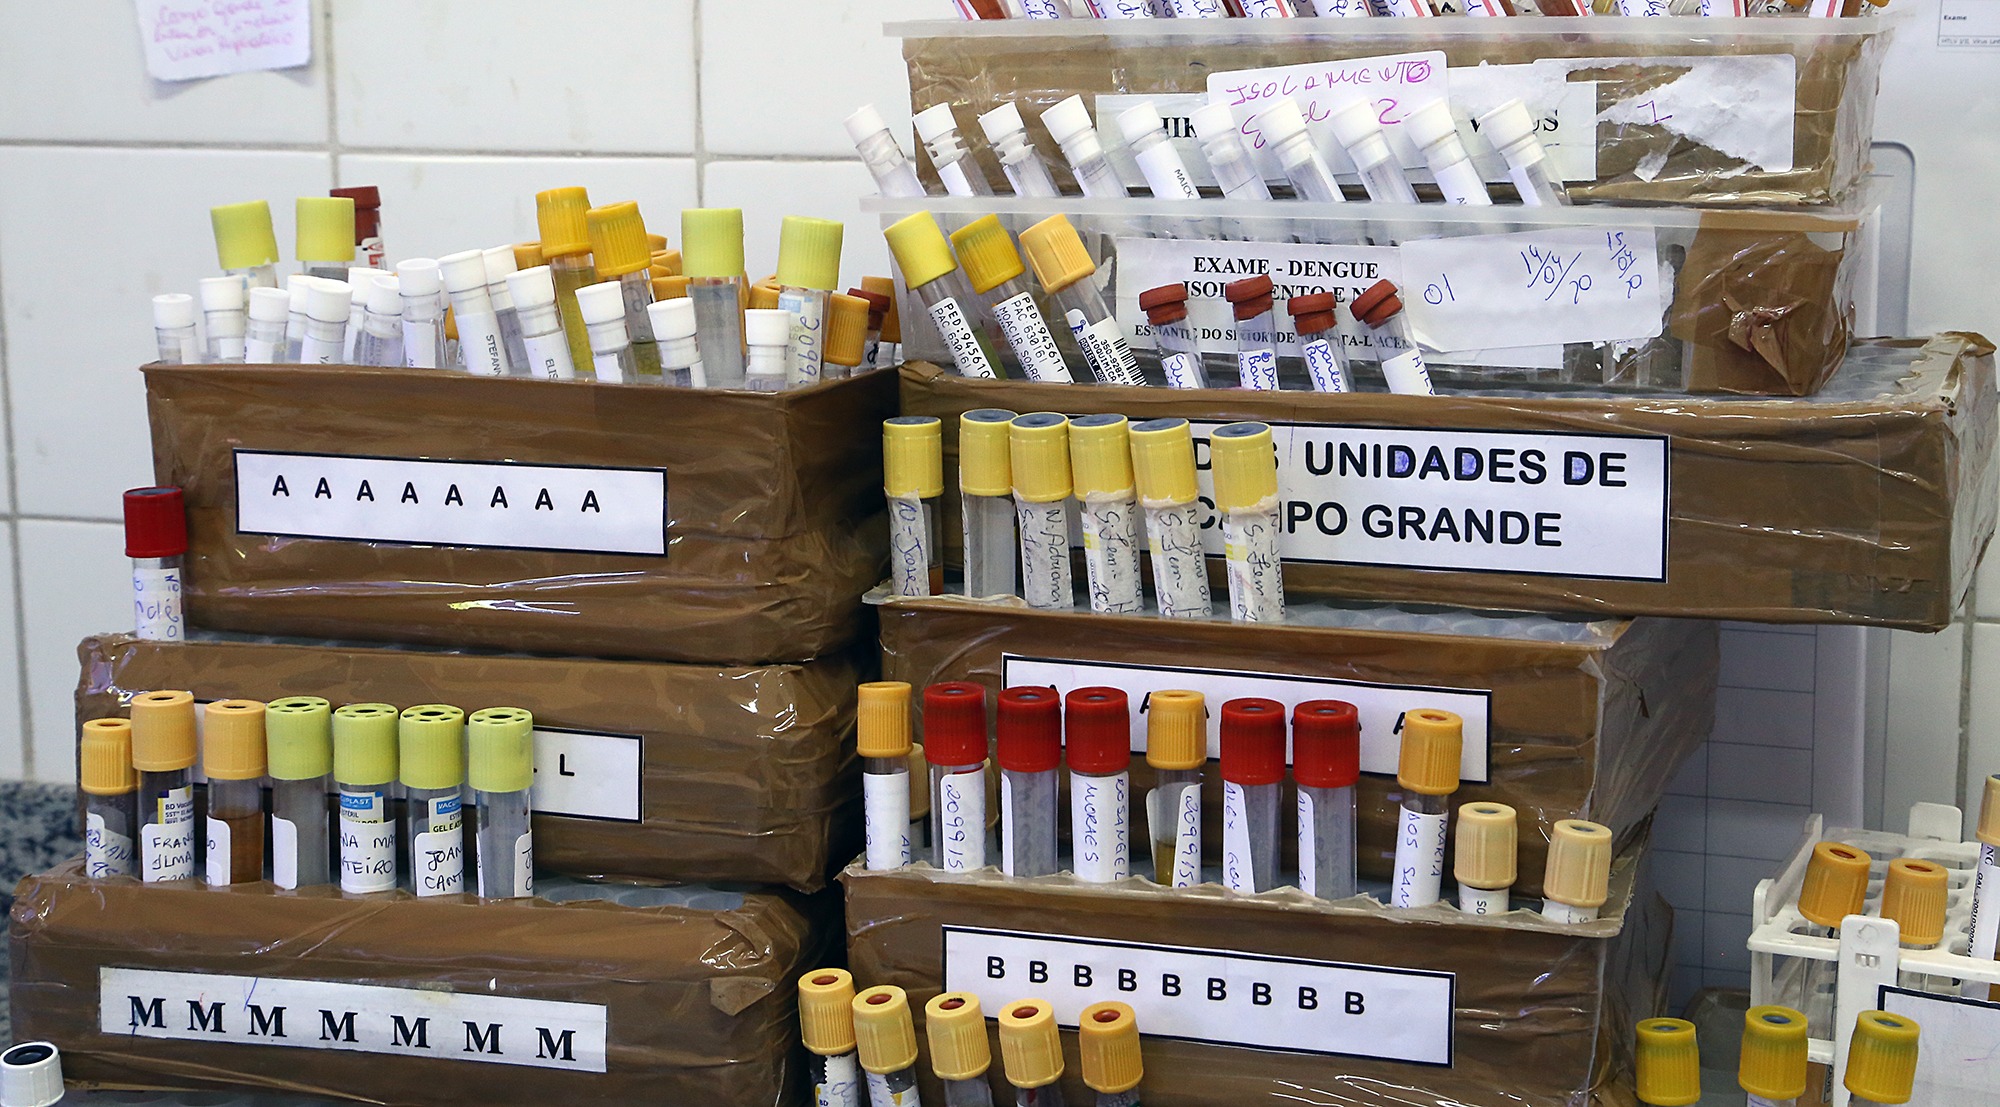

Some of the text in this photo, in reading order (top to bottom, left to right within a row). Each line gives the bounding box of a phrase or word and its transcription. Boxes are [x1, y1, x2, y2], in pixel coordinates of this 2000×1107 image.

[1194, 257, 1270, 274] EXAME
[1289, 260, 1379, 278] DENGUE
[1022, 297, 1065, 373] PED:945611
[1202, 328, 1222, 340] DO
[1277, 332, 1295, 344] DE
[1306, 440, 1547, 485] UNIDADES
[1564, 451, 1627, 487] DE
[273, 475, 600, 512] A A A A A A A A
[1362, 504, 1562, 547] GRANDE
[560, 753, 575, 777] L
[988, 956, 1364, 1014] B B B B B B B B B
[128, 996, 576, 1061] M M M M M M M
